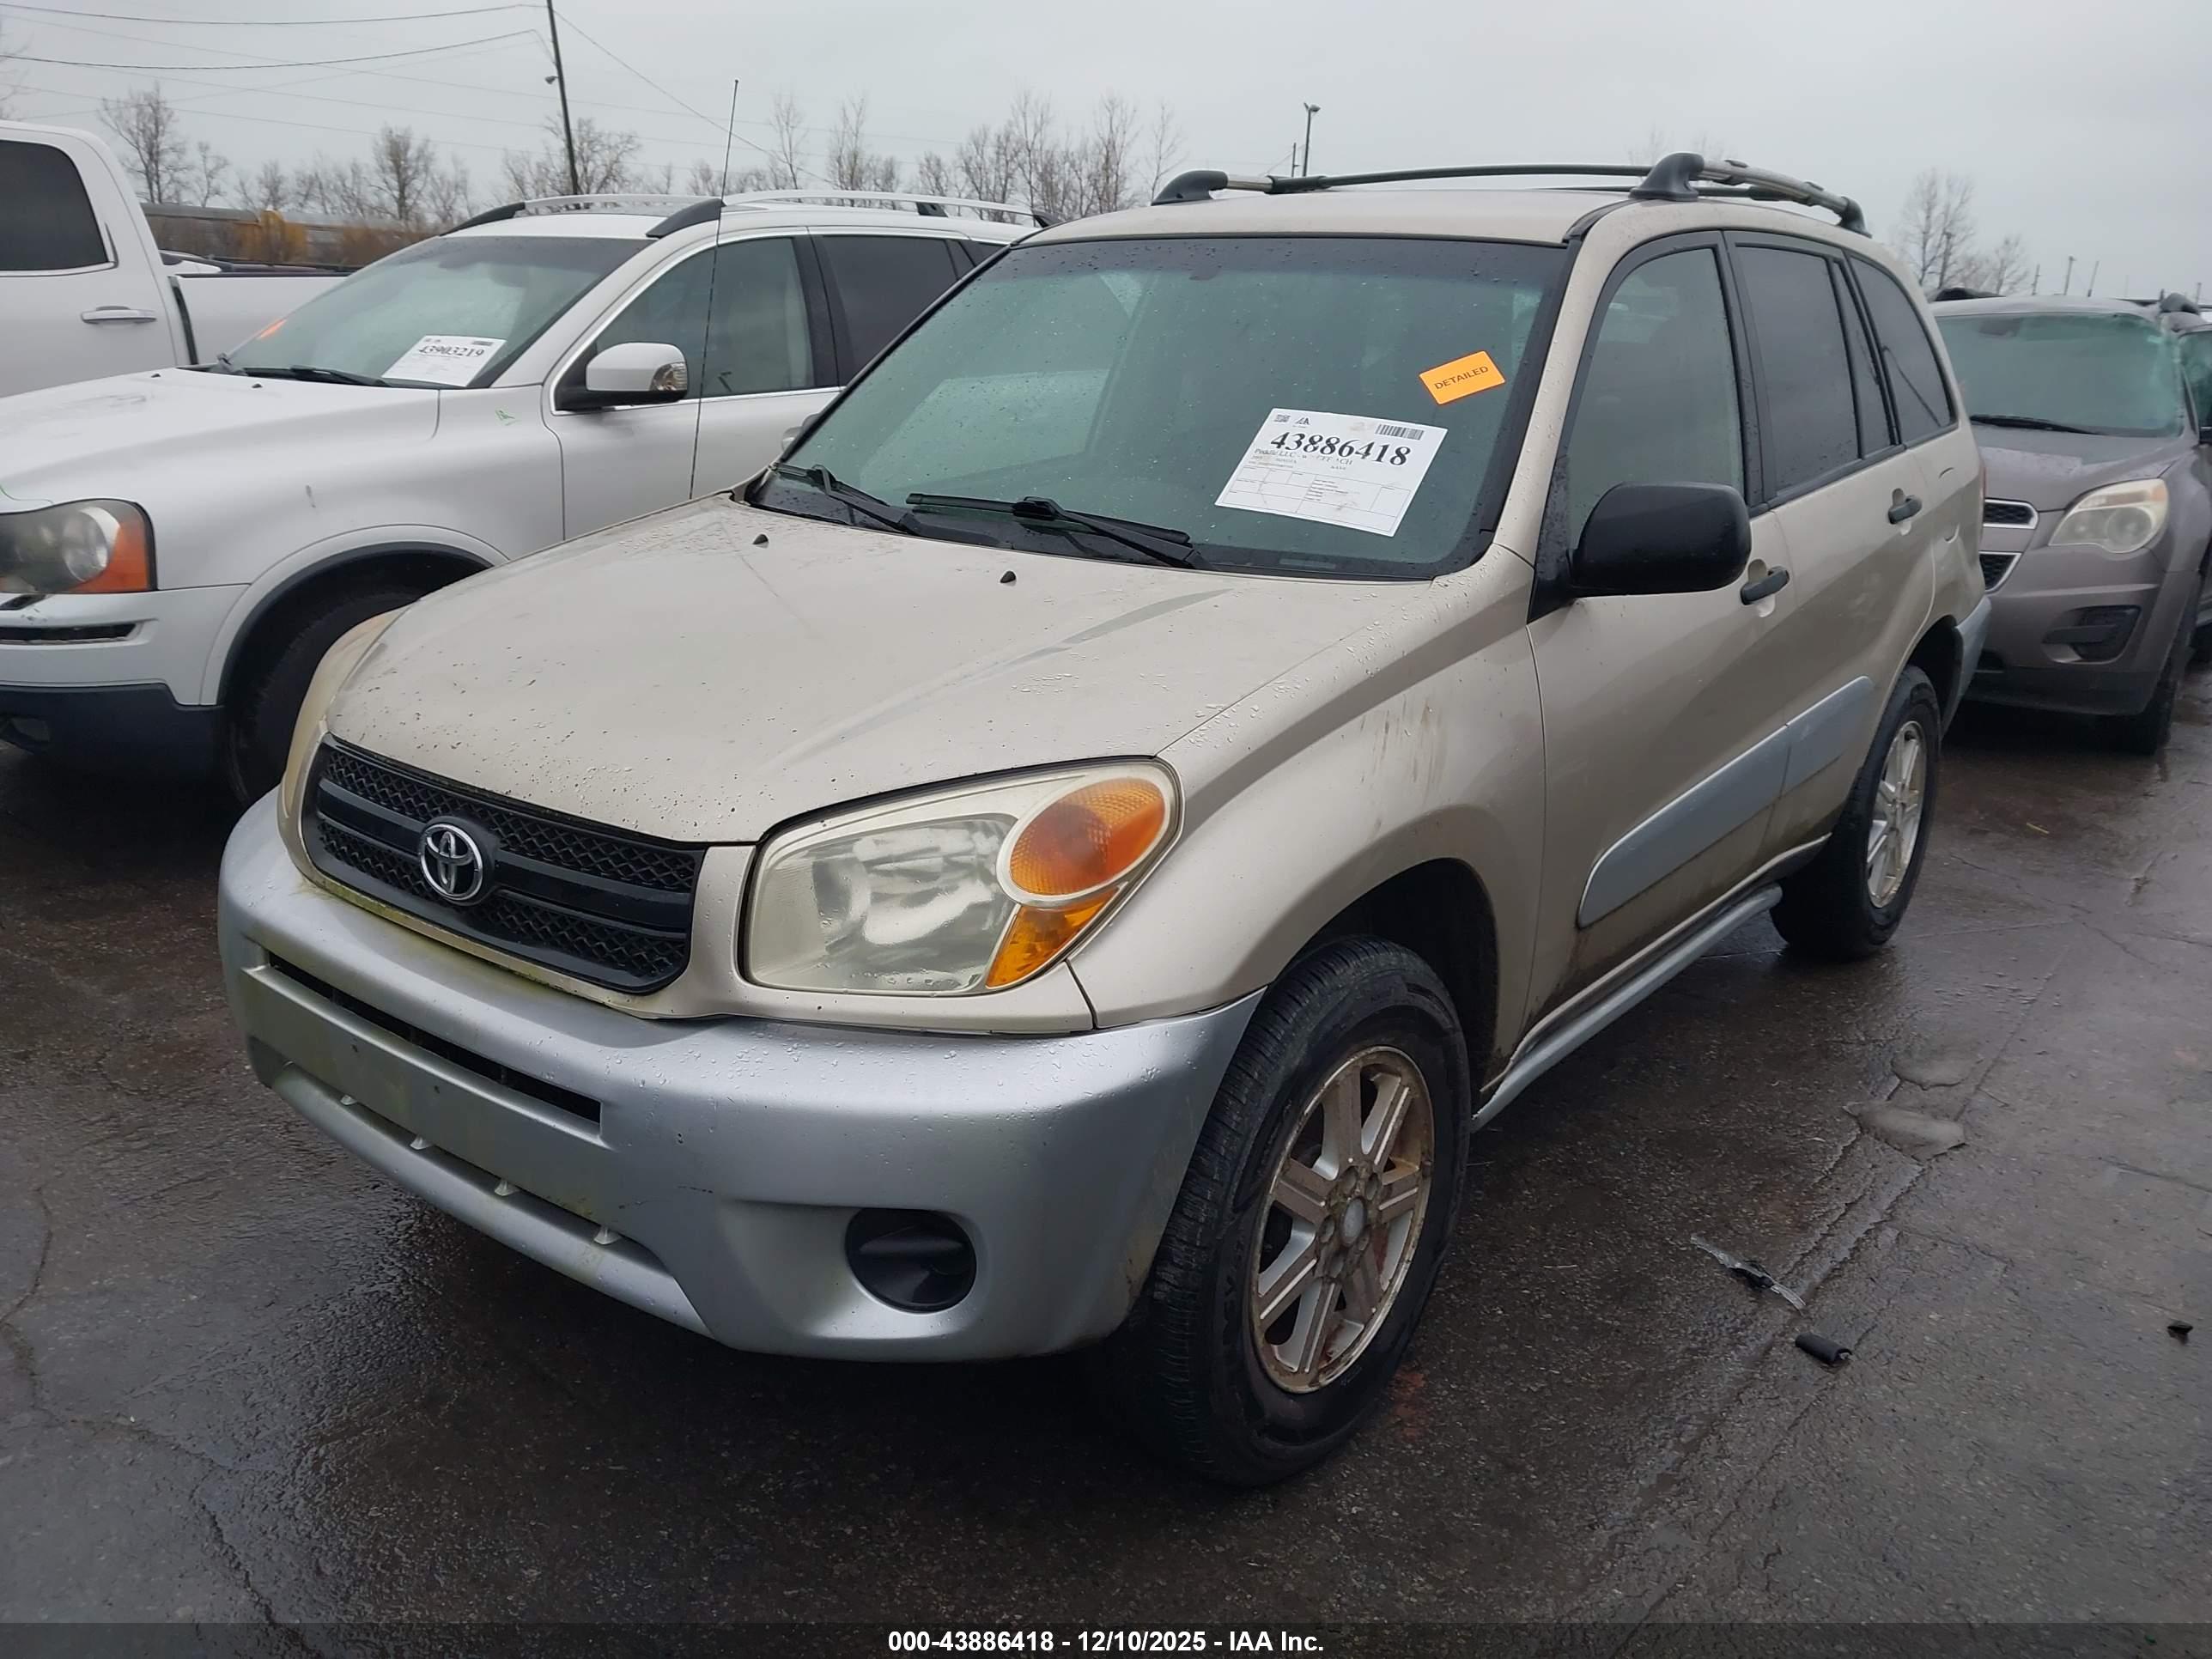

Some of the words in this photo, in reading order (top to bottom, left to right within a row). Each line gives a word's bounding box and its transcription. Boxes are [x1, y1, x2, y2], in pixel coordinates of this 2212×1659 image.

[418, 344, 484, 357] 43903219
[1434, 366, 1489, 390] DETAILED
[1270, 431, 1412, 466] 43886418
